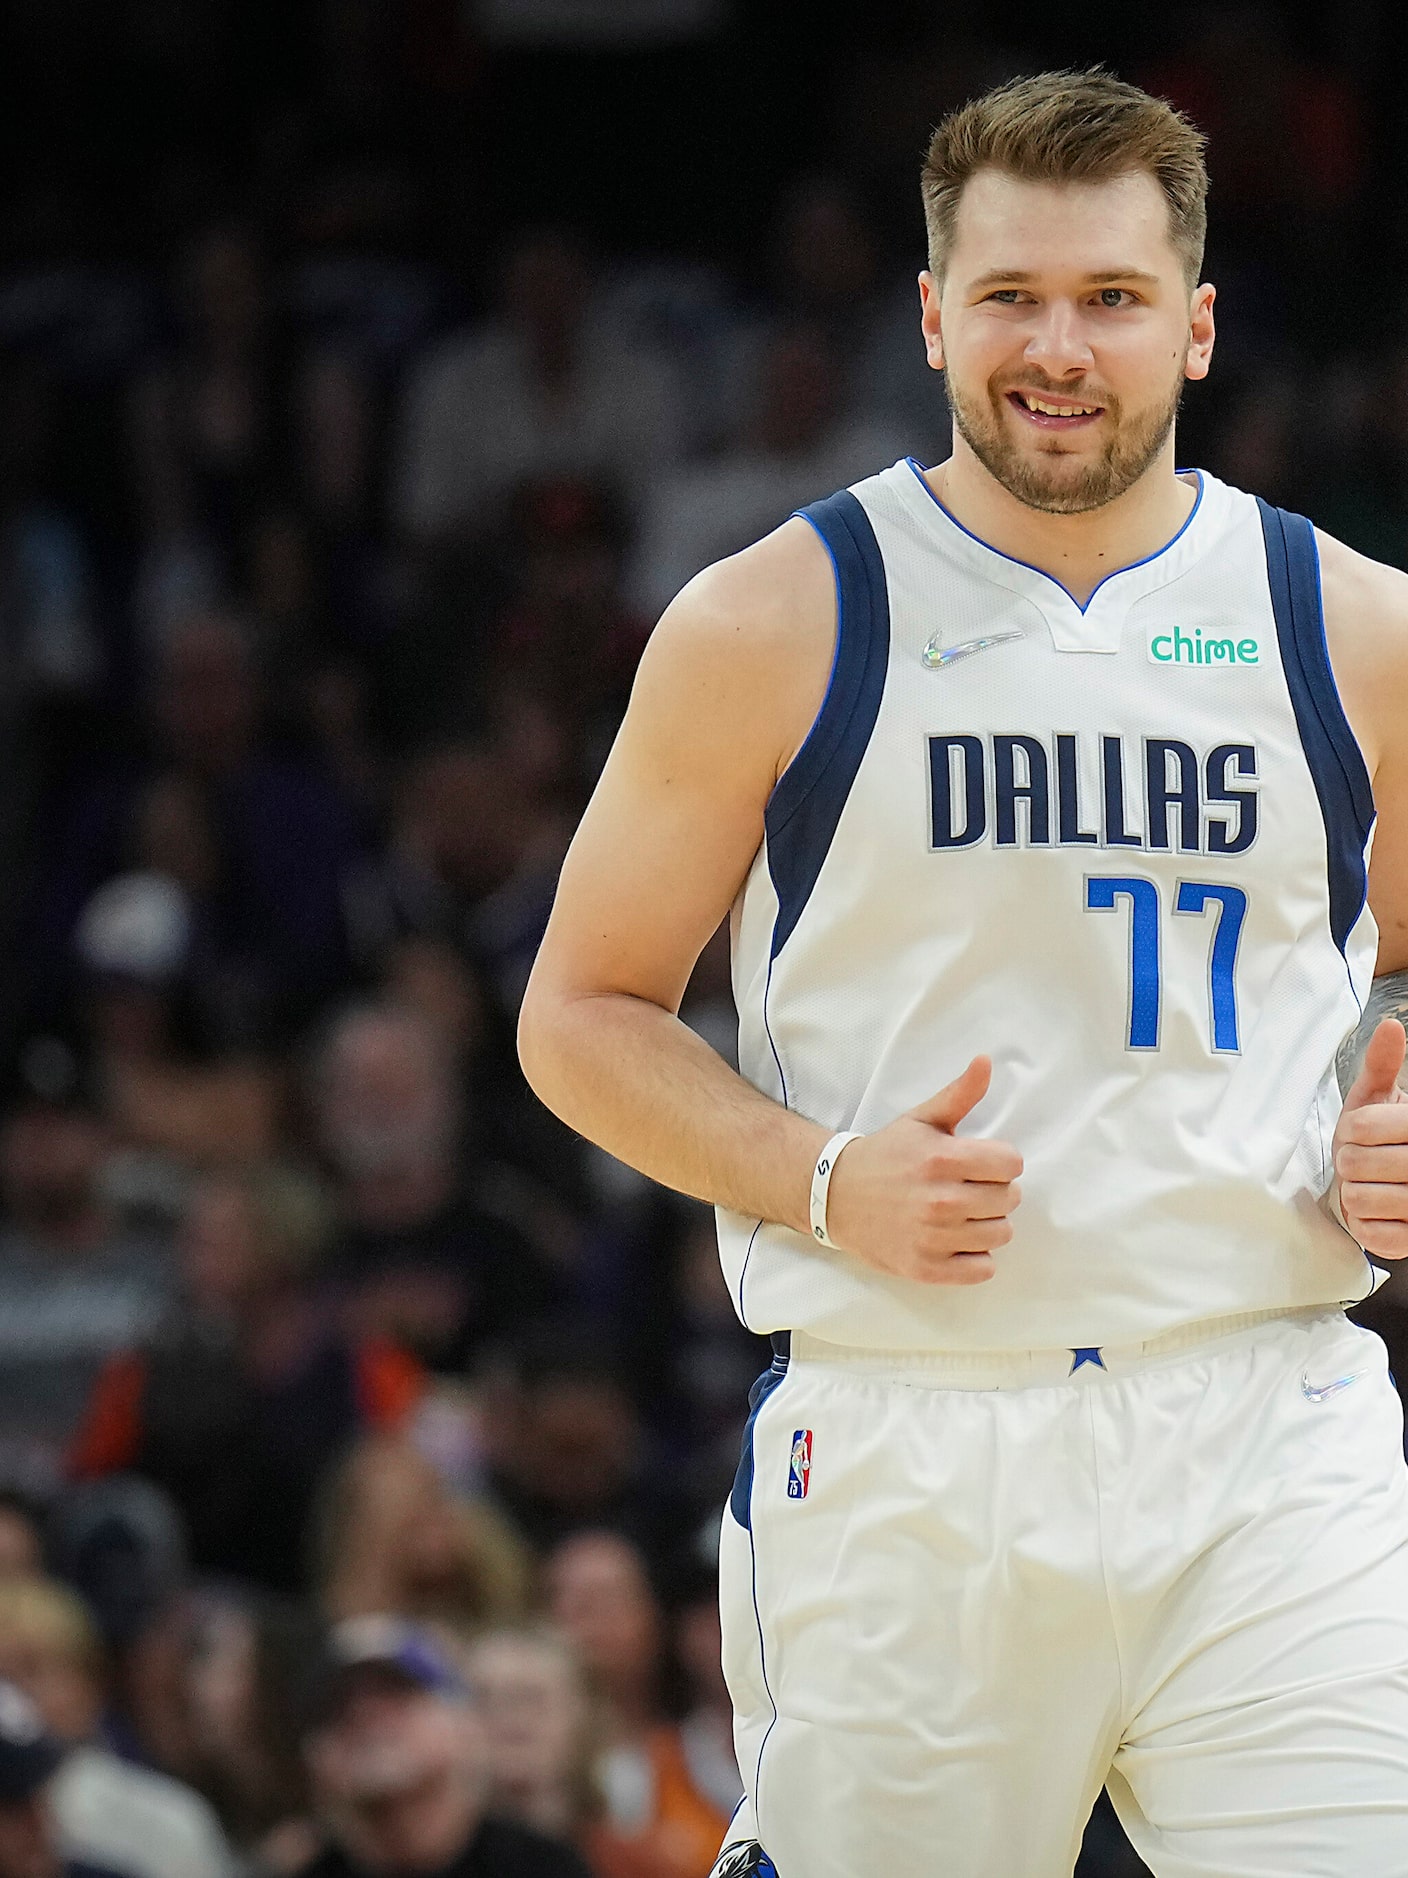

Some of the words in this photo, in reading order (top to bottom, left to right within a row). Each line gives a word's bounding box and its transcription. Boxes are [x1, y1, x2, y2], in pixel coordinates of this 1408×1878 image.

[1150, 625, 1260, 665] chime
[924, 730, 1261, 858] DALLAS
[1082, 873, 1250, 1056] 77
[789, 1480, 799, 1496] 75
